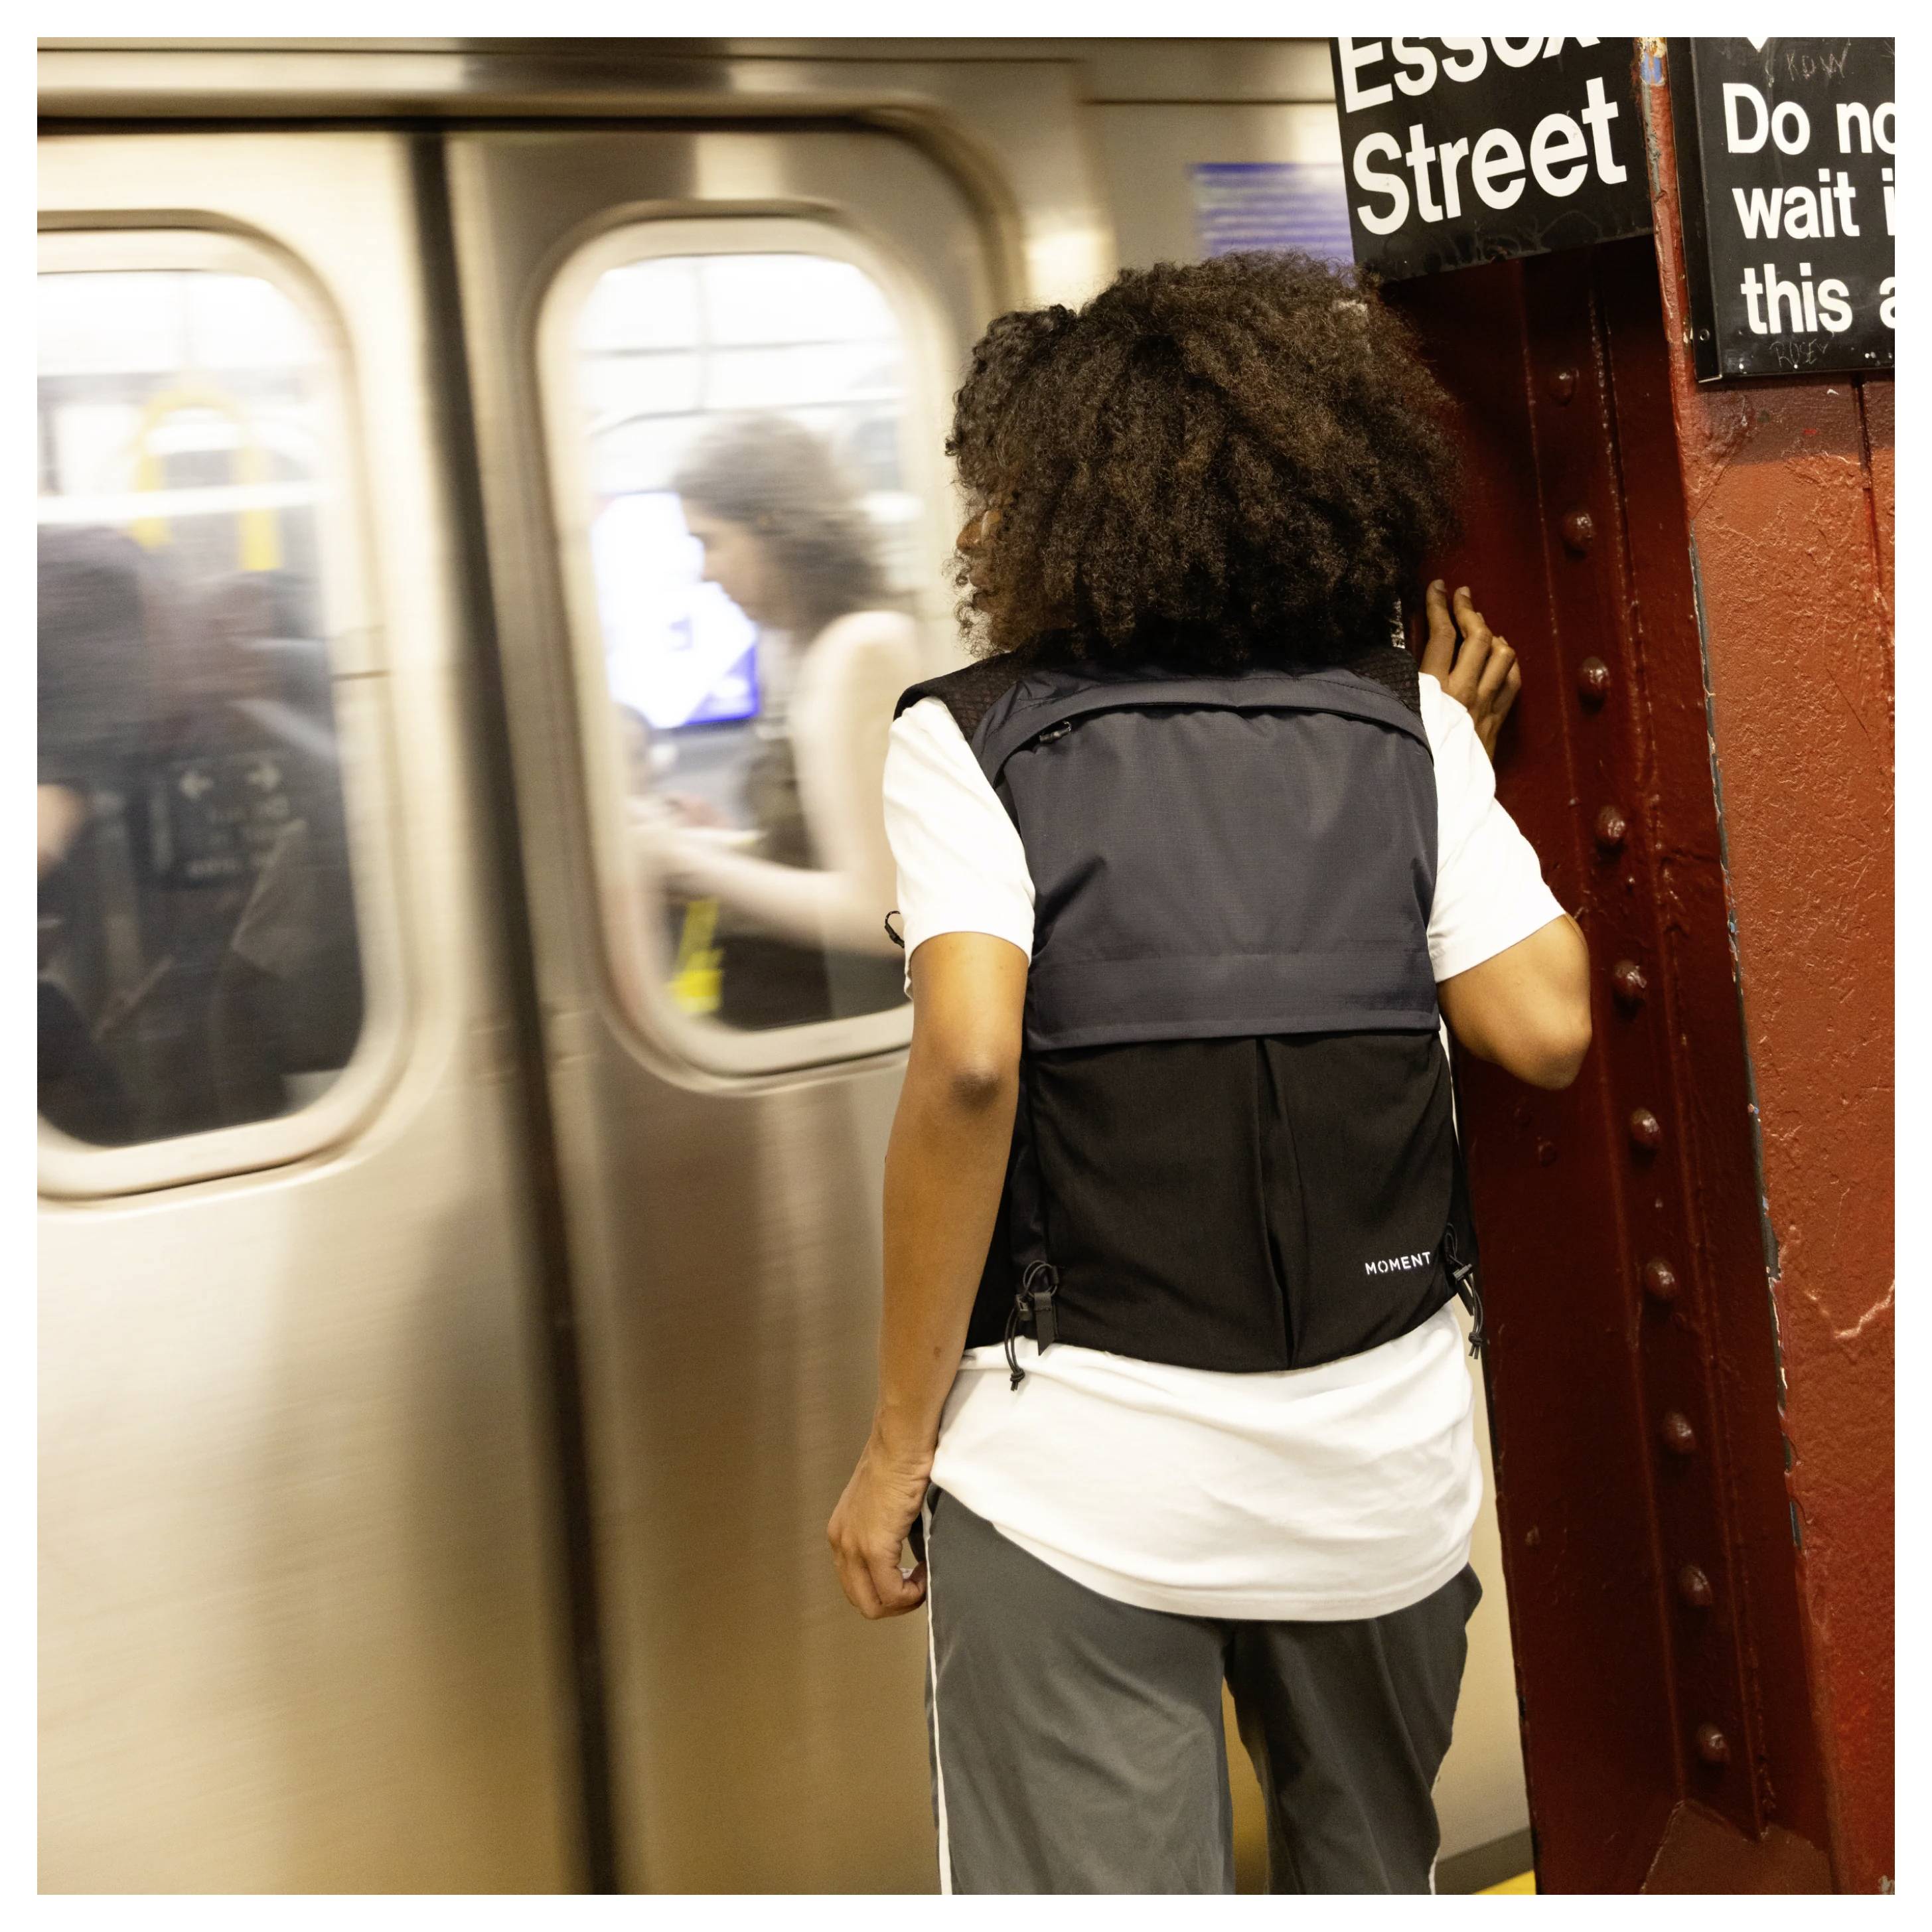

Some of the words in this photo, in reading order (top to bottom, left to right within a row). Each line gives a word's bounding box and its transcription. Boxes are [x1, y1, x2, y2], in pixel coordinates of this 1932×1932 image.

[1338, 37, 1601, 113] Ess
[1722, 82, 1811, 155] Do
[1353, 77, 1627, 235] Street
[1732, 168, 1860, 240] wait
[1740, 262, 1853, 334] this
[1365, 1251, 1431, 1275] MOMENT
